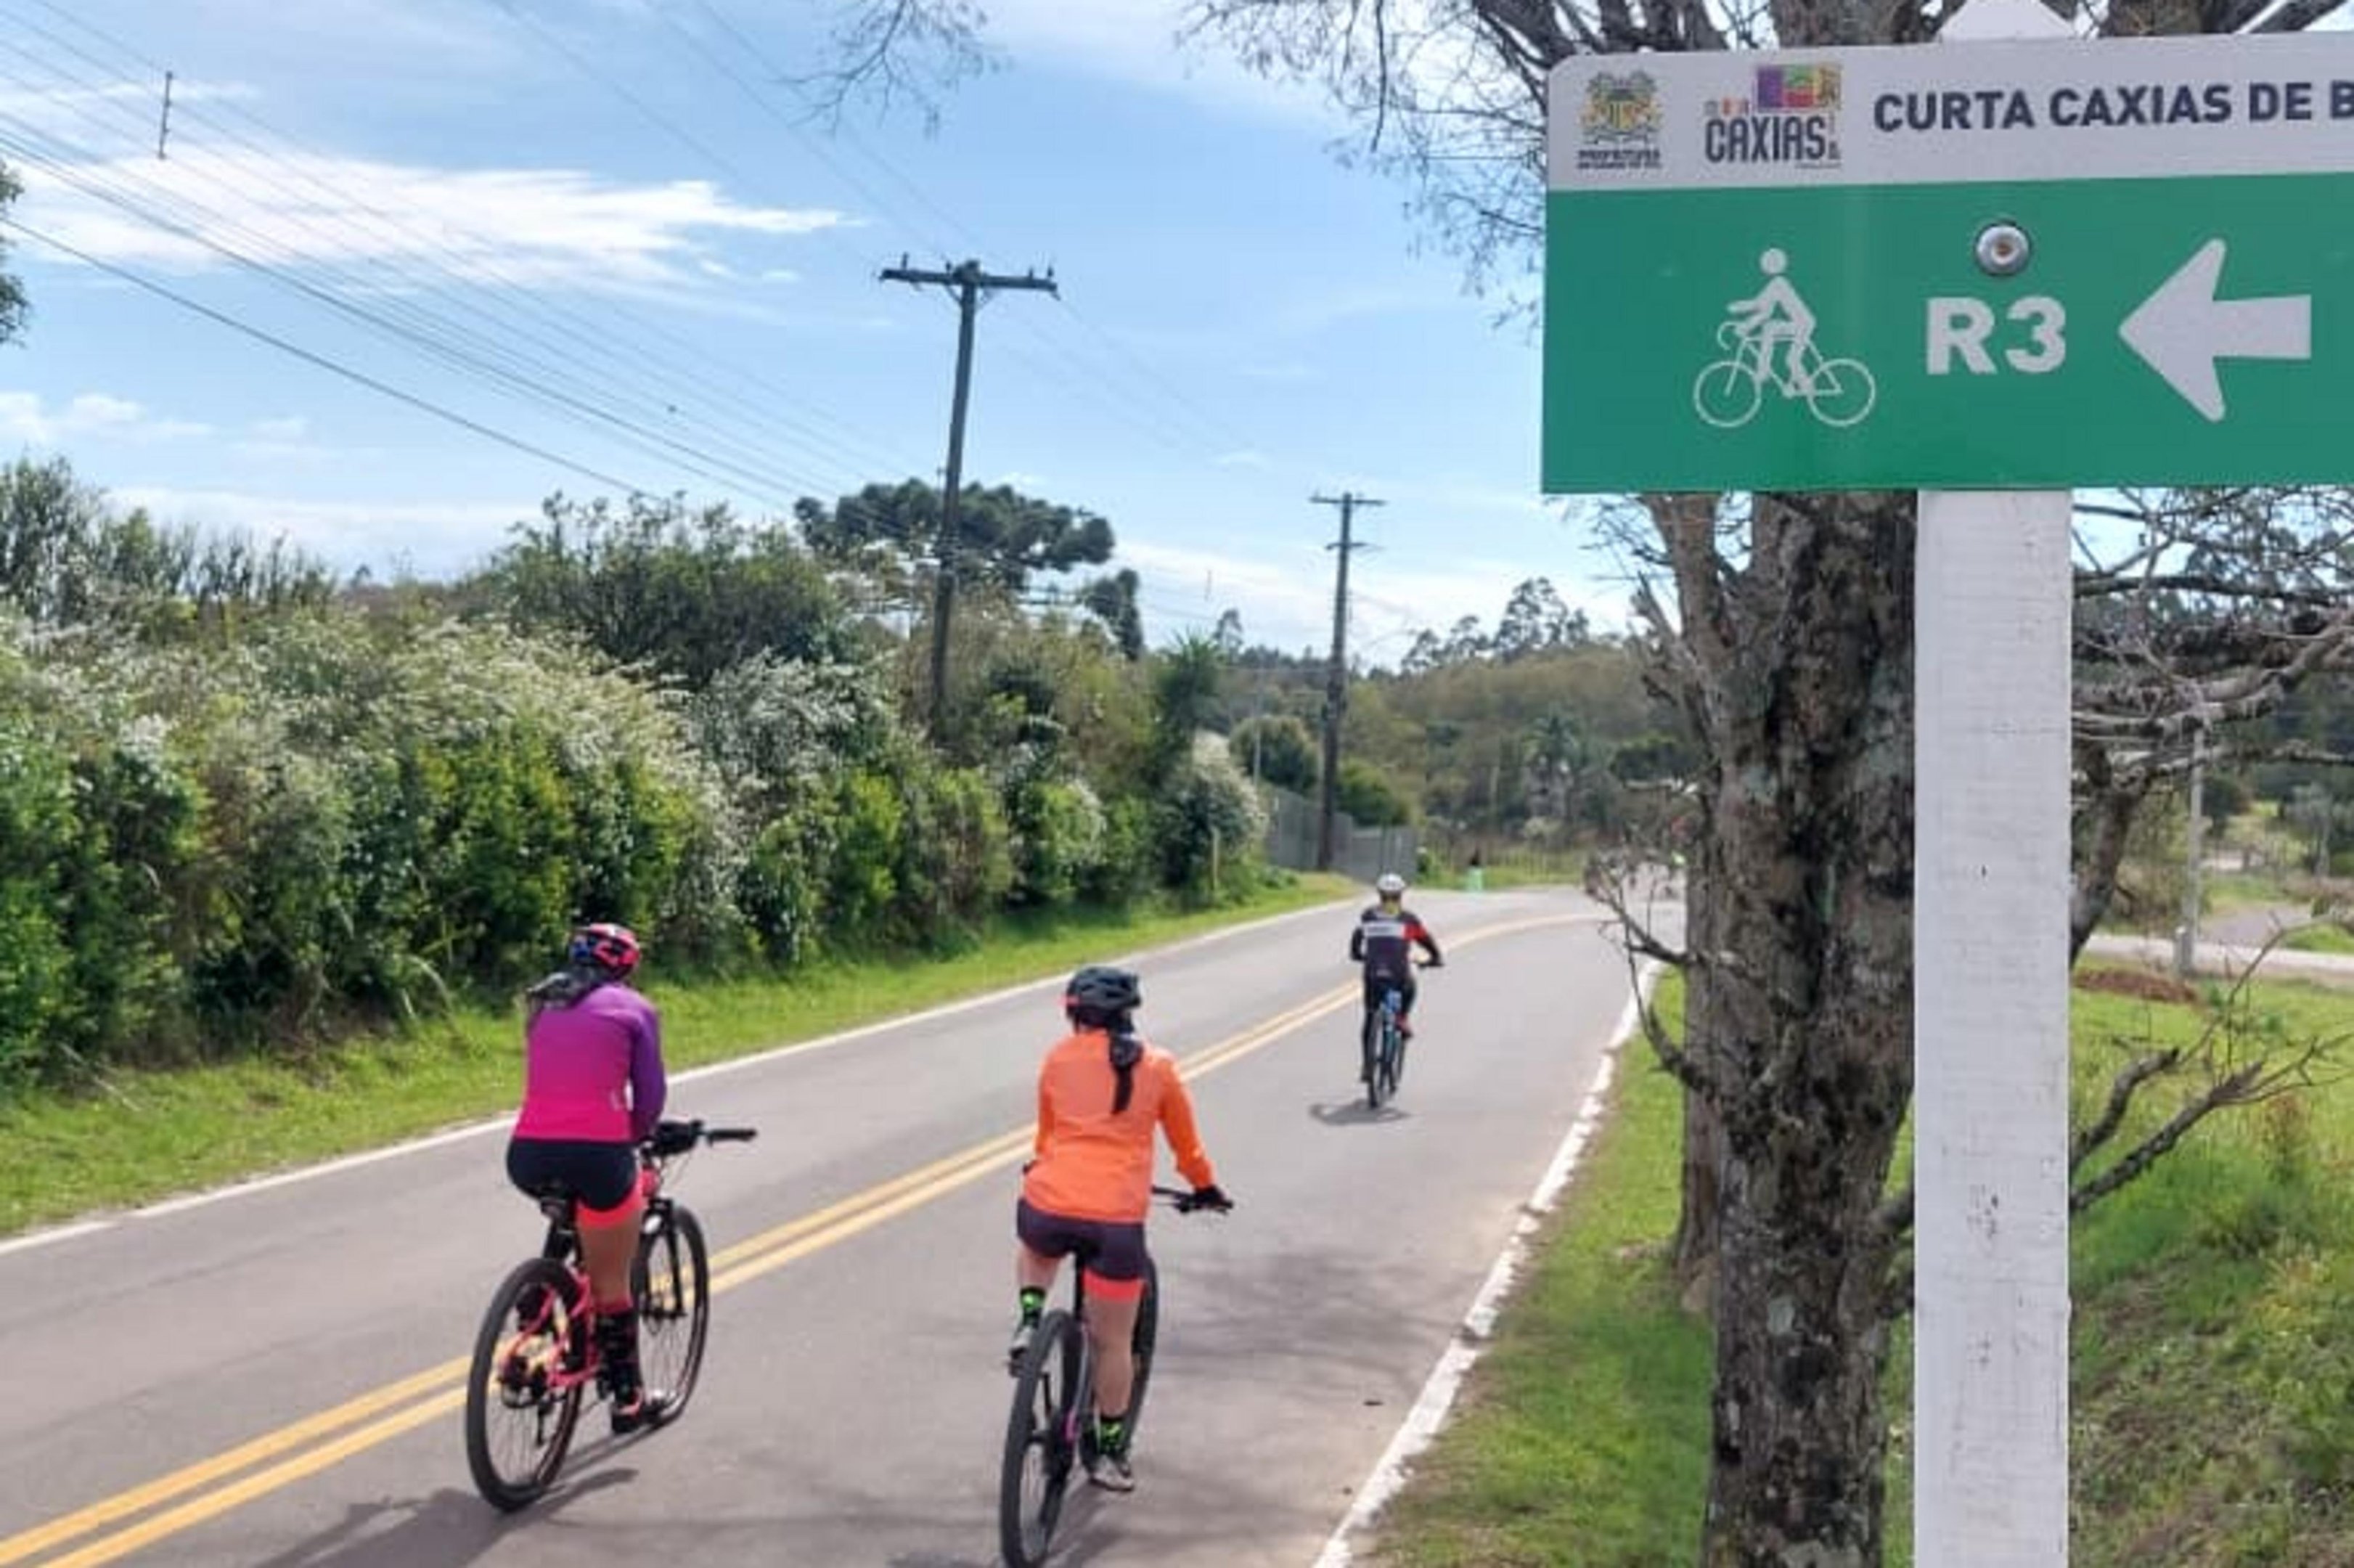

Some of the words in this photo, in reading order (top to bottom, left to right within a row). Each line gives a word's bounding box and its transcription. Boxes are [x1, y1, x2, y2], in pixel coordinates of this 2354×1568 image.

[1874, 89, 2035, 132] CURTA
[2048, 83, 2232, 125] CAXIAS
[2249, 82, 2311, 122] DE
[2330, 80, 2354, 120] B
[1705, 115, 1826, 163] CAXIAS
[1926, 296, 2066, 375] R3
